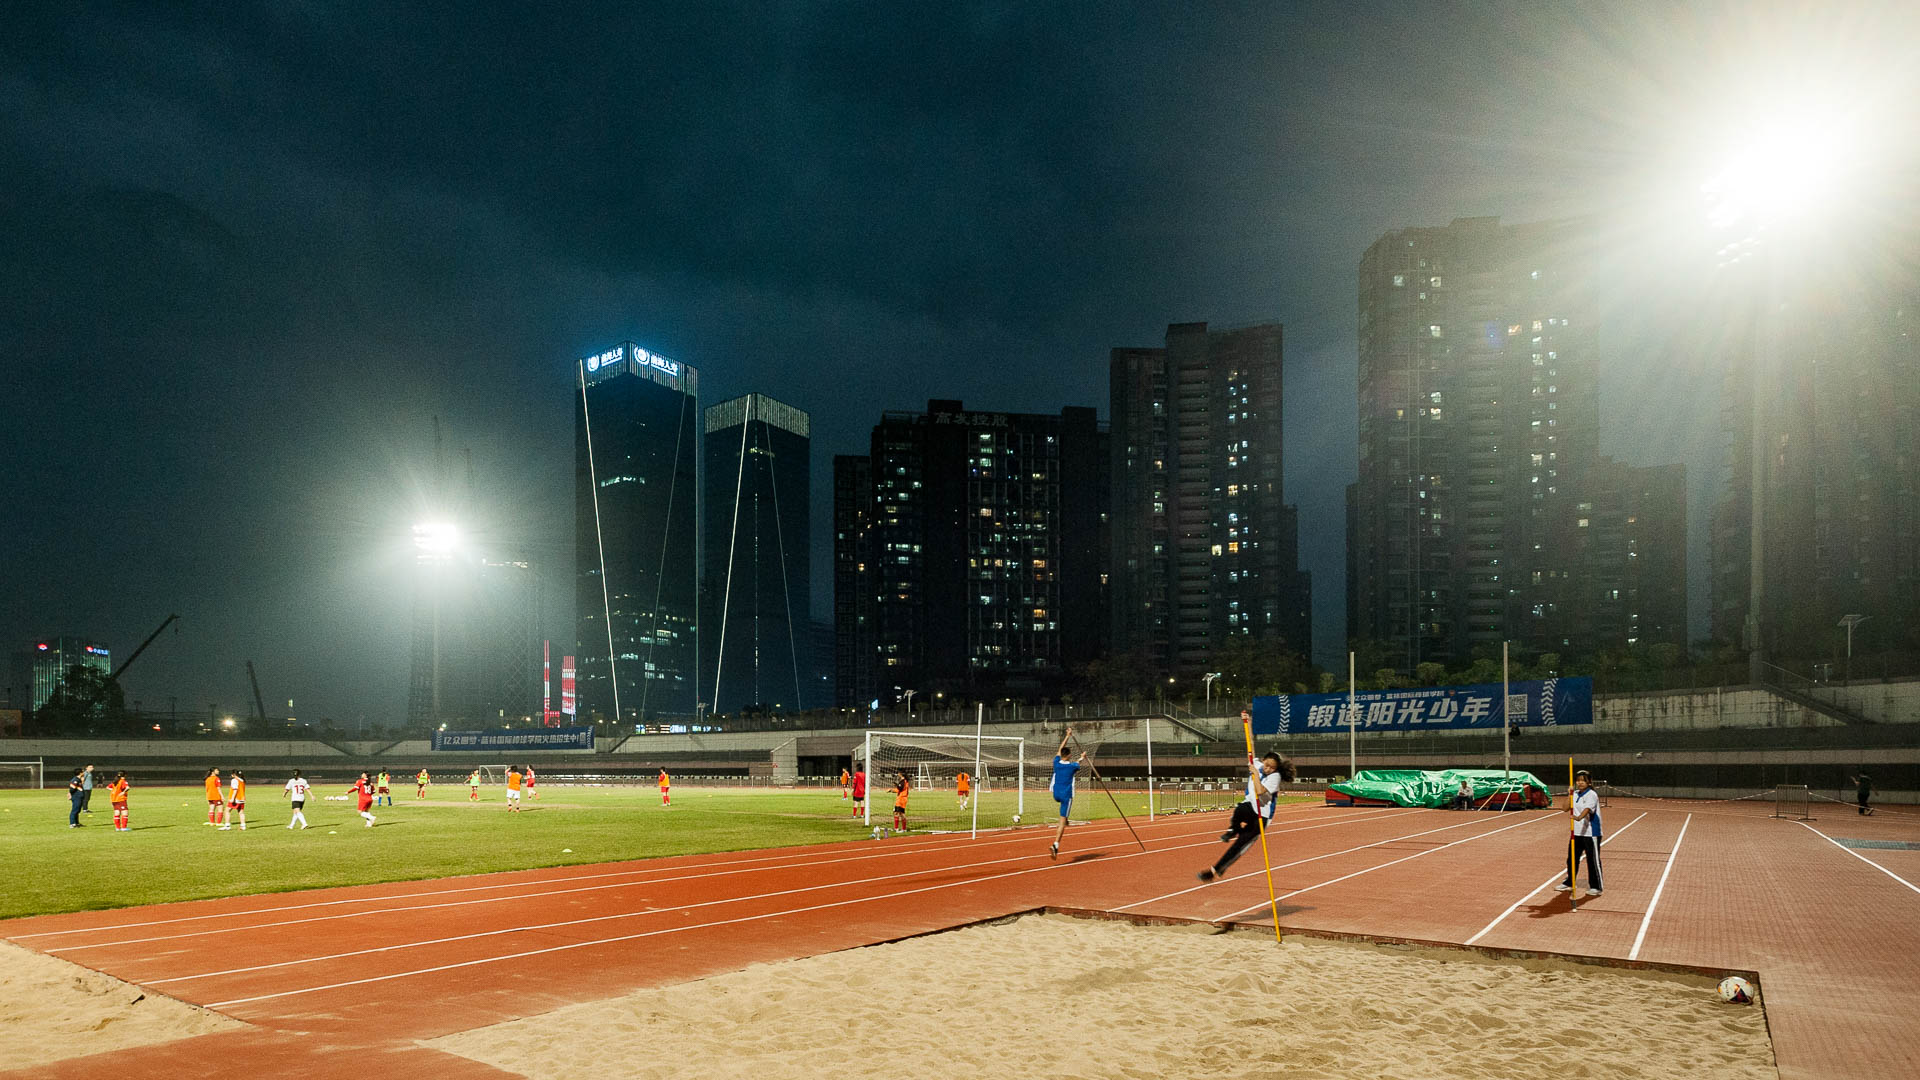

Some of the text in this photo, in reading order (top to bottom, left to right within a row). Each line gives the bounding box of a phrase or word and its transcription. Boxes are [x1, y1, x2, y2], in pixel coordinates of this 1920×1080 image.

[1307, 697, 1493, 728] 锻造阳光少年
[294, 785, 304, 794] 13
[364, 785, 372, 794] 18
